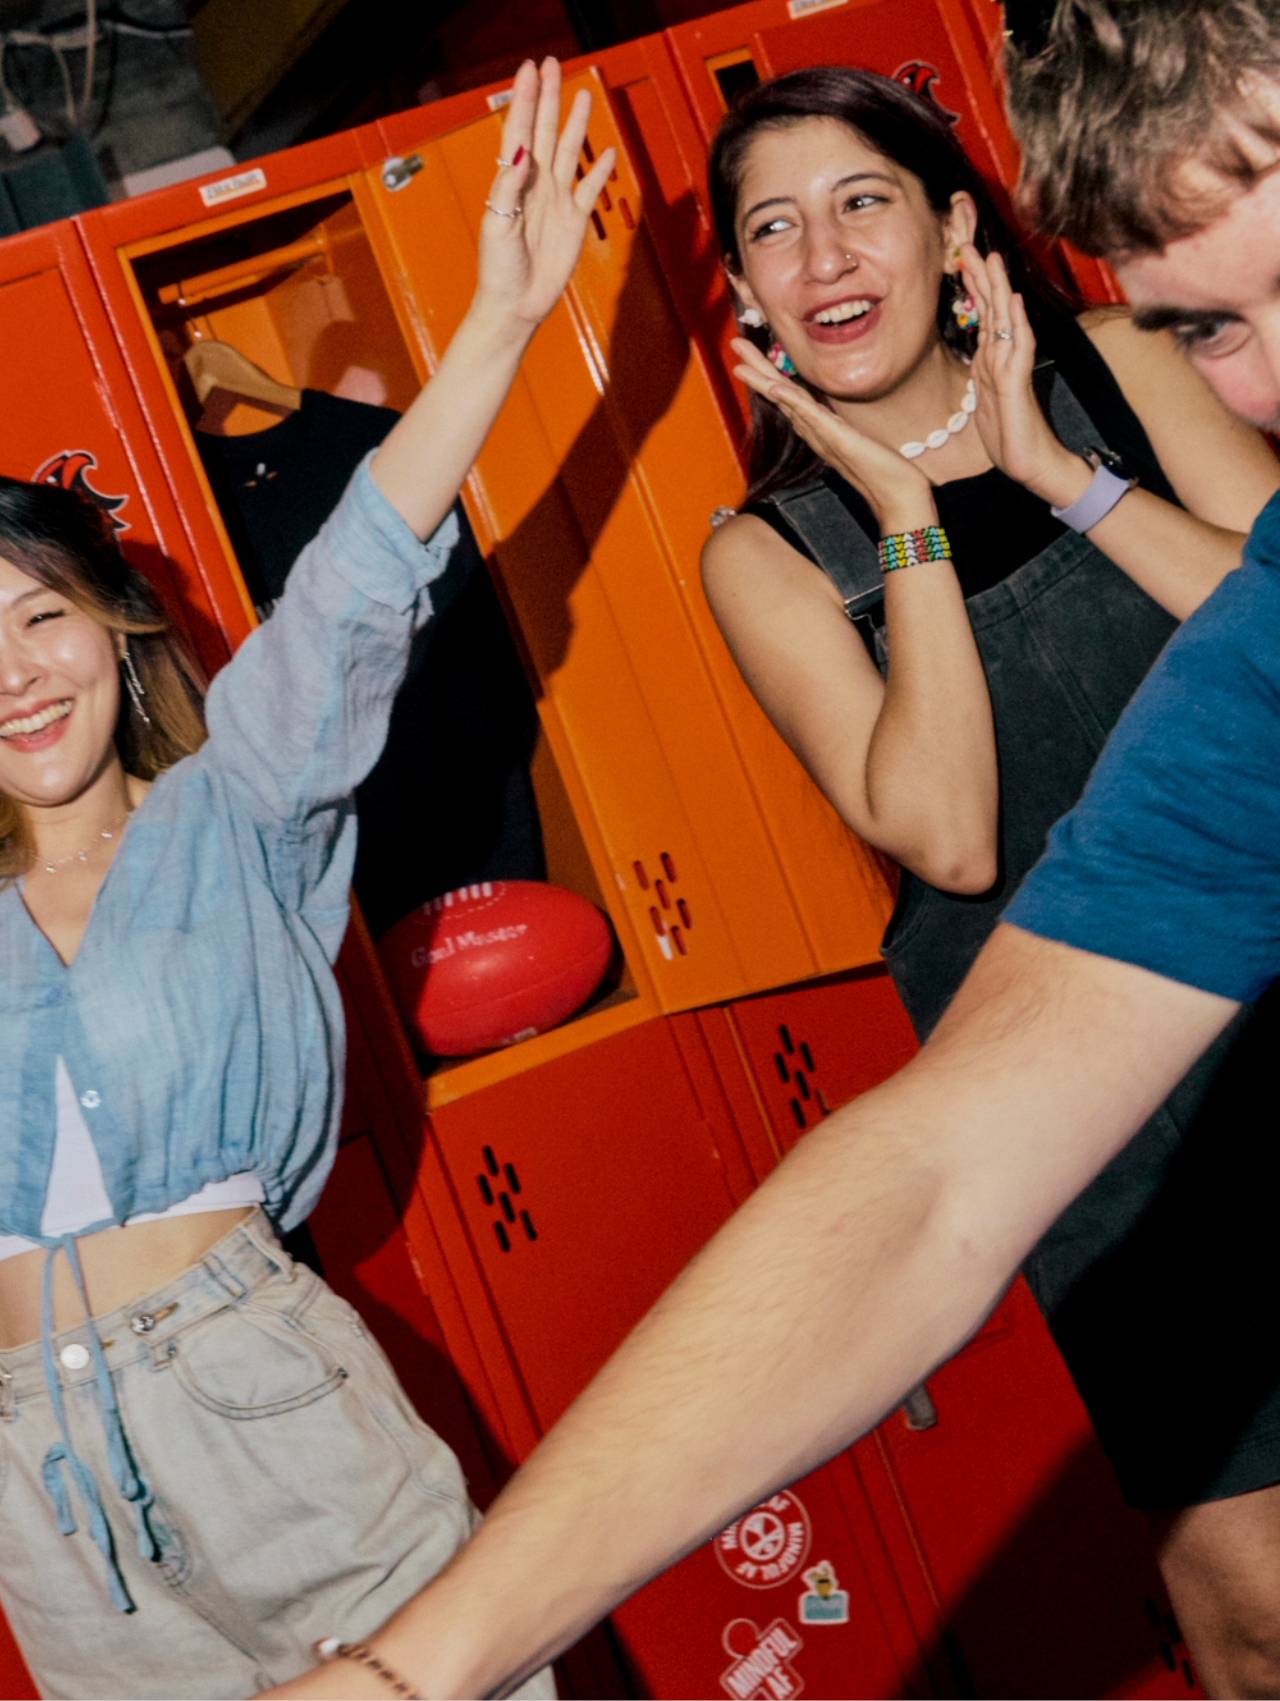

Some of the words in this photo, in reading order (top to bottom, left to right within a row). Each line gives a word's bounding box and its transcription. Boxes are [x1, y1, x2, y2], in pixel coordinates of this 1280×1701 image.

[456, 923, 528, 950] Master
[727, 1627, 798, 1699] MINDFUL
[765, 1665, 795, 1700] AF
